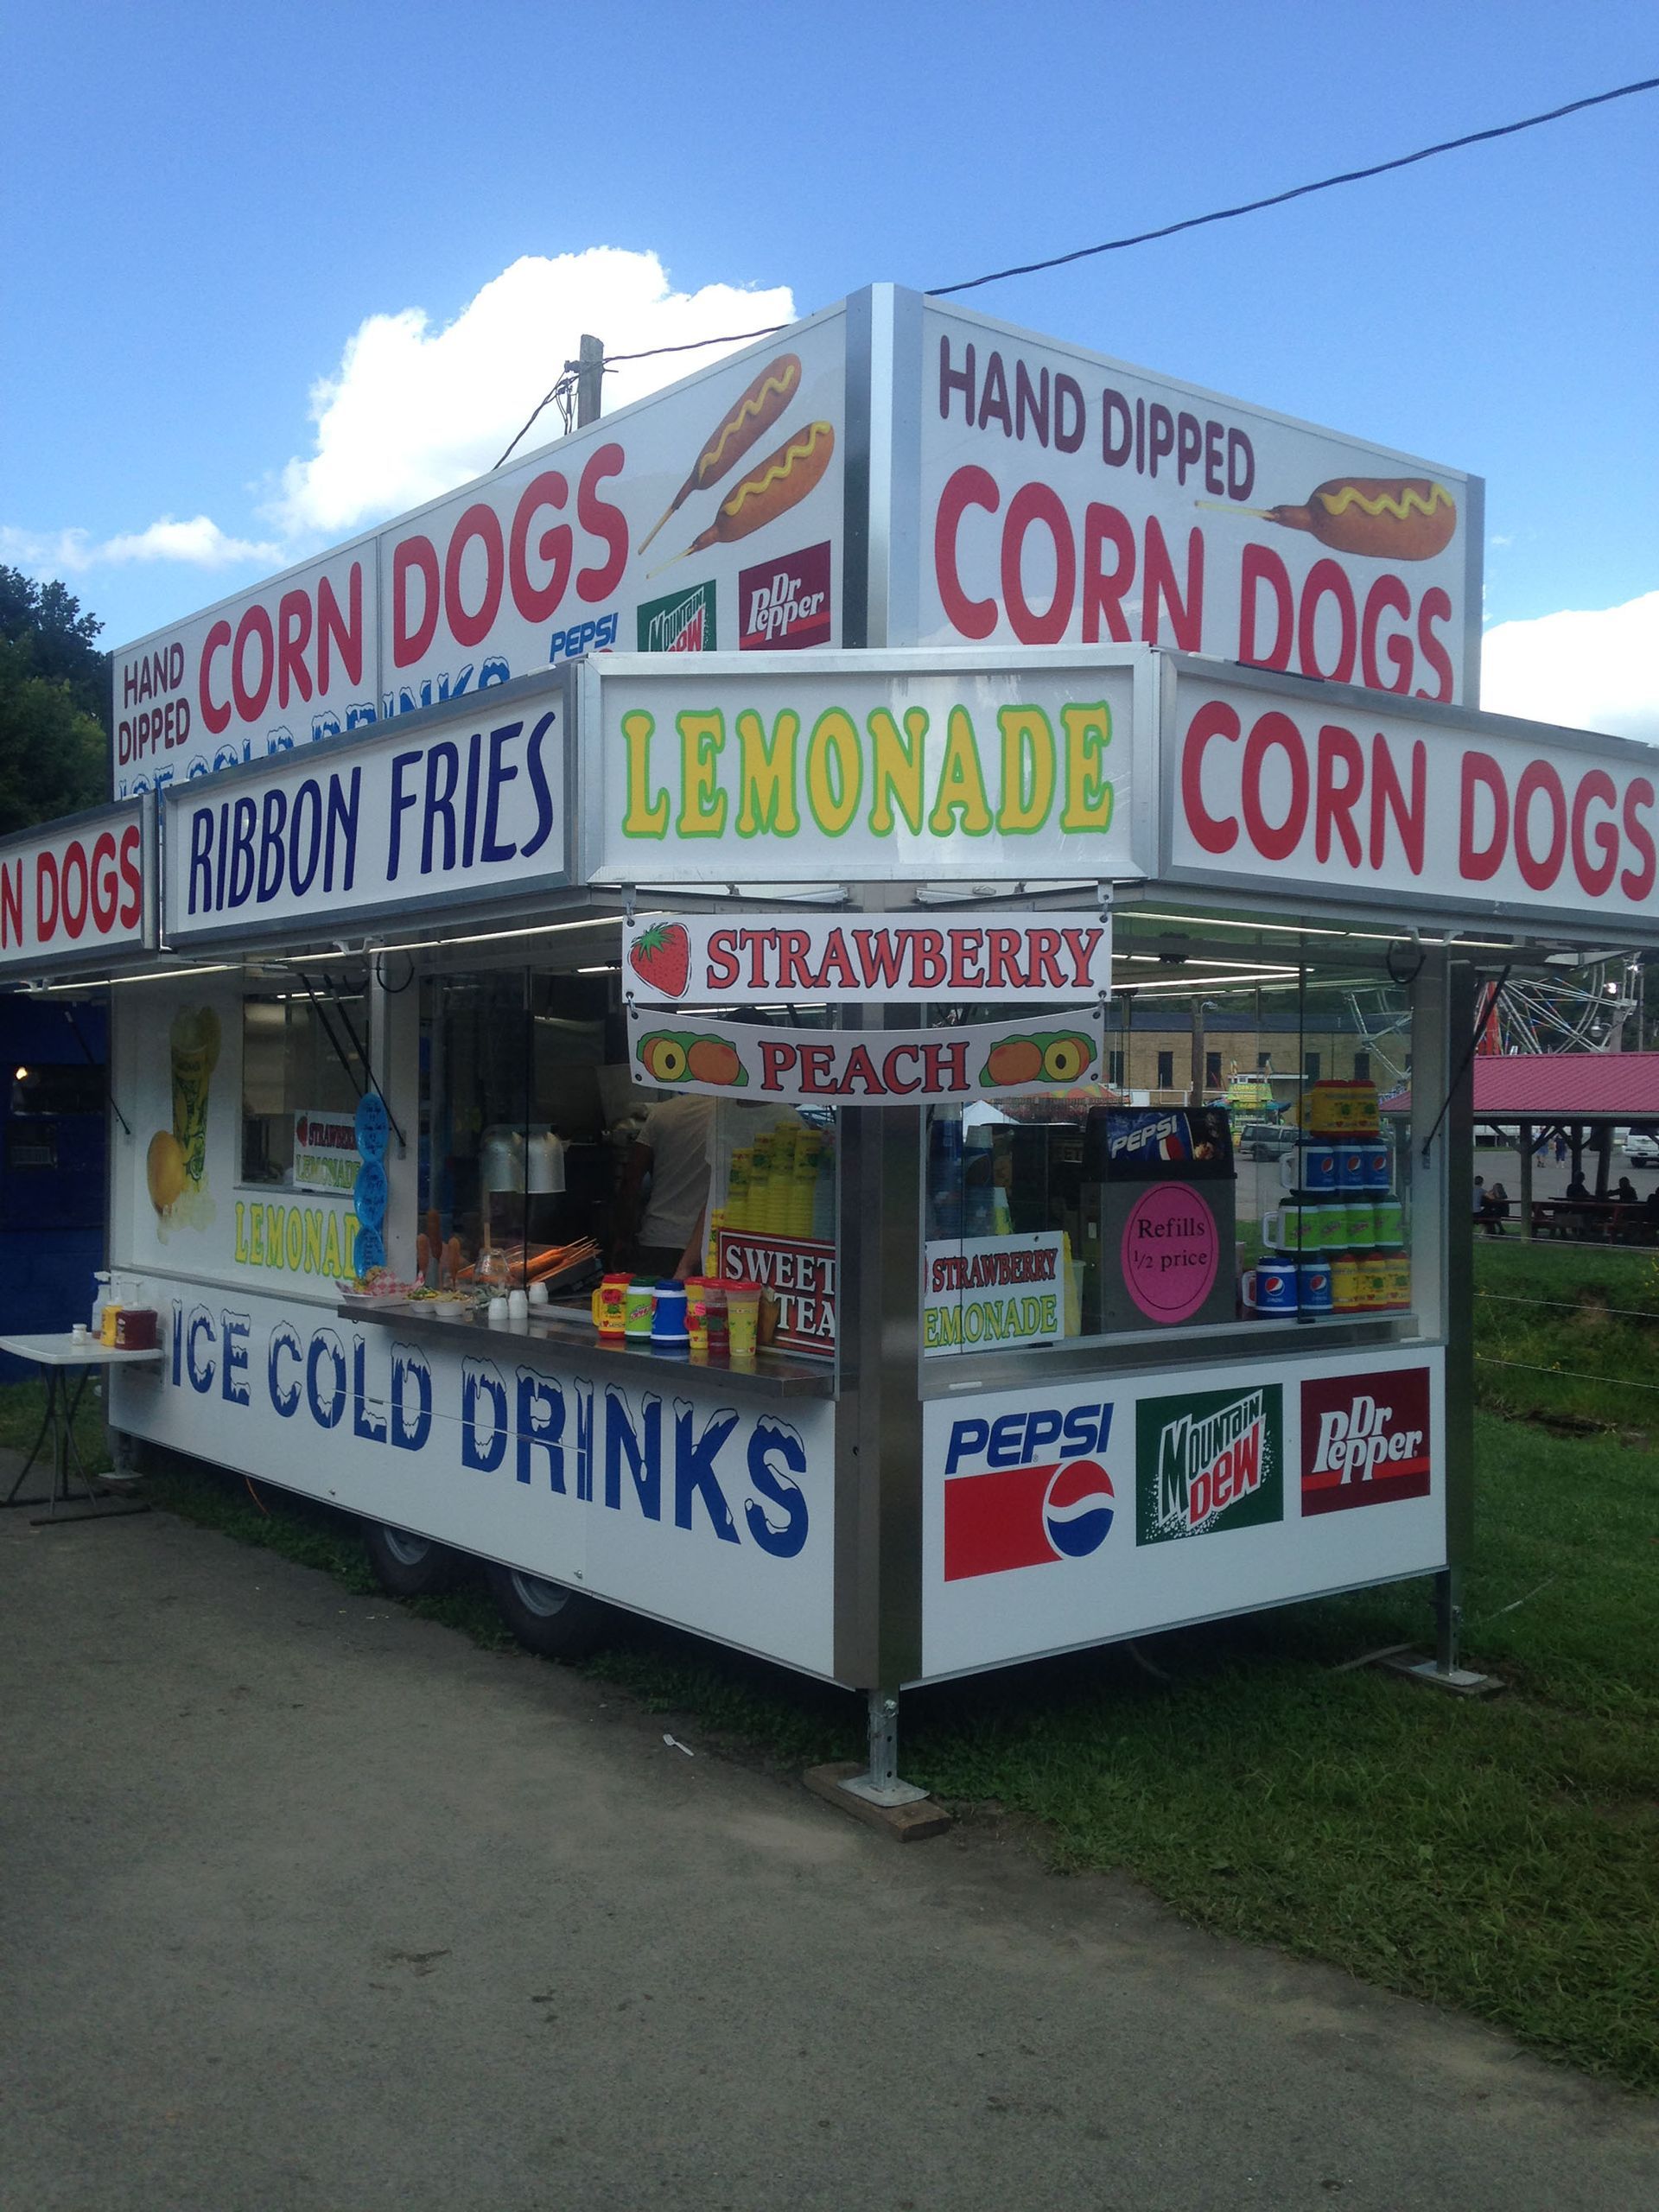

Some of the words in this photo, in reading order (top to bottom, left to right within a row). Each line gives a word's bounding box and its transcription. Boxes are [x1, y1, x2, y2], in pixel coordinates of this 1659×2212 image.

[938, 335, 1086, 454] HAND
[1103, 388, 1255, 501] DIPPED
[200, 562, 363, 734] CORN
[393, 442, 629, 669] DOGS
[747, 588, 824, 640] Pepper
[770, 573, 801, 604] Dr
[934, 464, 1205, 653] CORN
[1239, 543, 1453, 704] DOGS
[549, 612, 619, 663] PEPSI
[124, 642, 184, 709] HAND
[118, 697, 190, 766] DIPPED
[621, 700, 1114, 841] LEMONADE
[1181, 701, 1427, 875] CORN
[1459, 750, 1657, 902] DOGS
[188, 766, 361, 915] RIBBON
[386, 711, 556, 881] FRIES
[37, 825, 141, 943] DOGS
[706, 926, 1103, 989] STRAWBERRY
[757, 1041, 969, 1095] PEACH
[1111, 1115, 1178, 1160] PEPSI
[235, 1201, 359, 1280] LEMONAD
[1137, 1217, 1205, 1239] Refills
[1160, 1249, 1207, 1272] price
[725, 1244, 836, 1295] SWEET
[932, 1248, 1058, 1293] STRAWBERRY
[774, 1293, 836, 1338] TEA
[924, 1294, 1058, 1348] EMONADE
[172, 1298, 251, 1406] ICE
[268, 1319, 433, 1452] COLD
[461, 1356, 809, 1559] DRINKS
[945, 1402, 1115, 1475] PEPSI
[1312, 1410, 1423, 1484] Pepper
[1346, 1395, 1392, 1439] Dr
